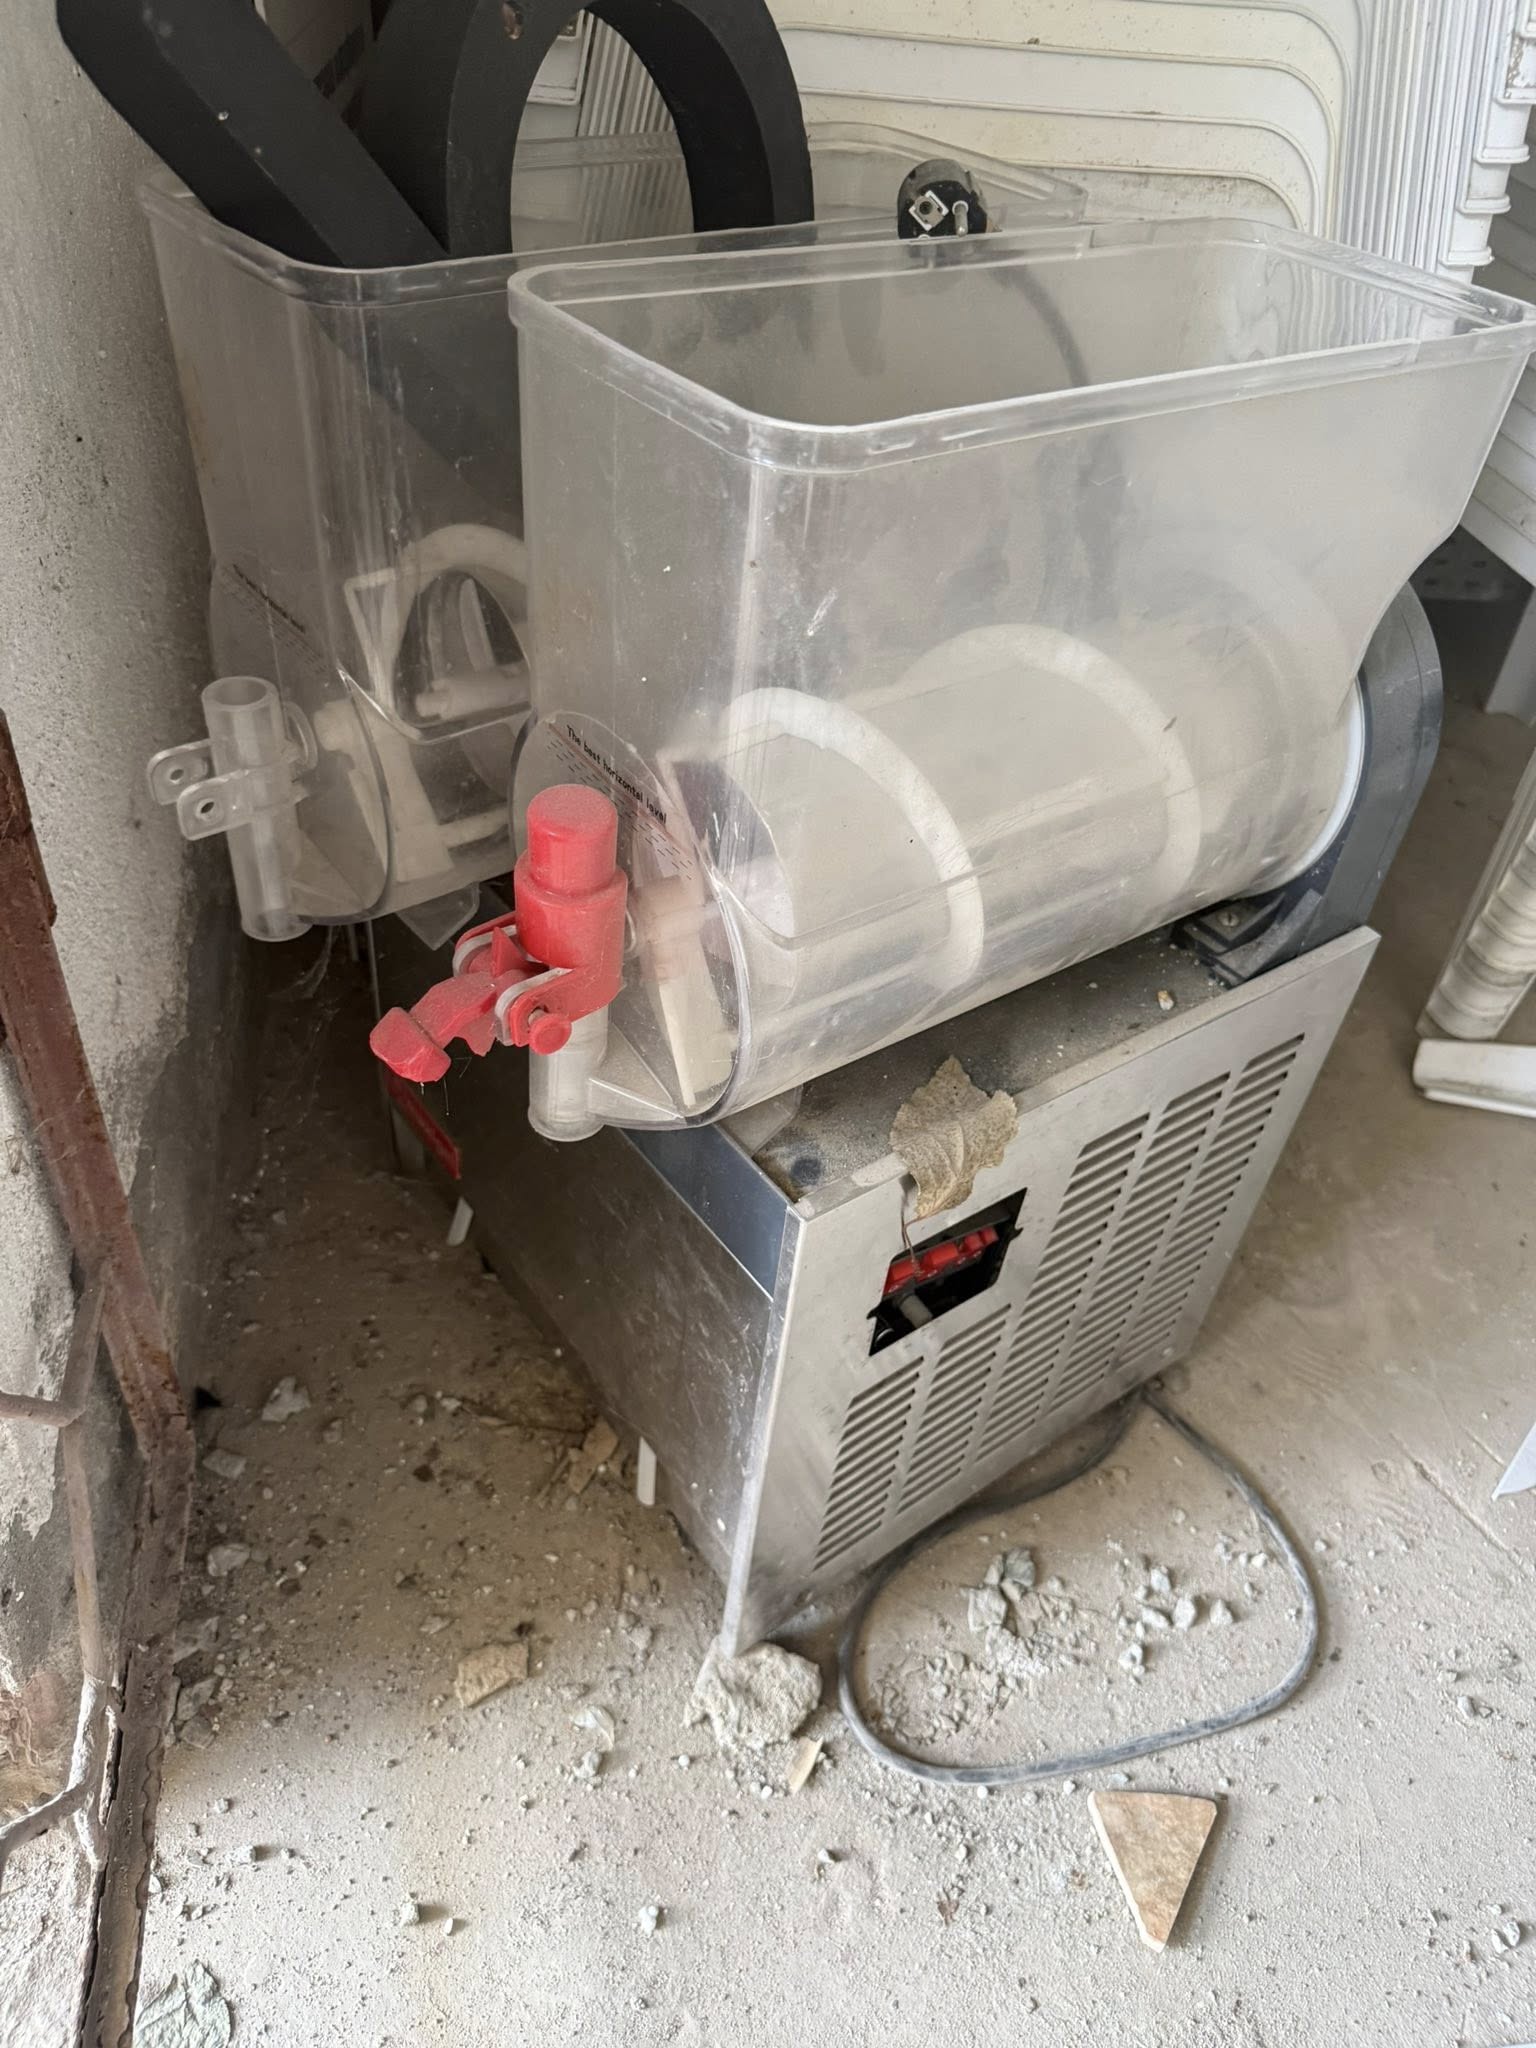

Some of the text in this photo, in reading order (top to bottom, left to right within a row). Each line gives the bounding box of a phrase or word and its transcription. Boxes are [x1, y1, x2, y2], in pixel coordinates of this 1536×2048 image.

[567, 724, 667, 823] The best horizontal level
